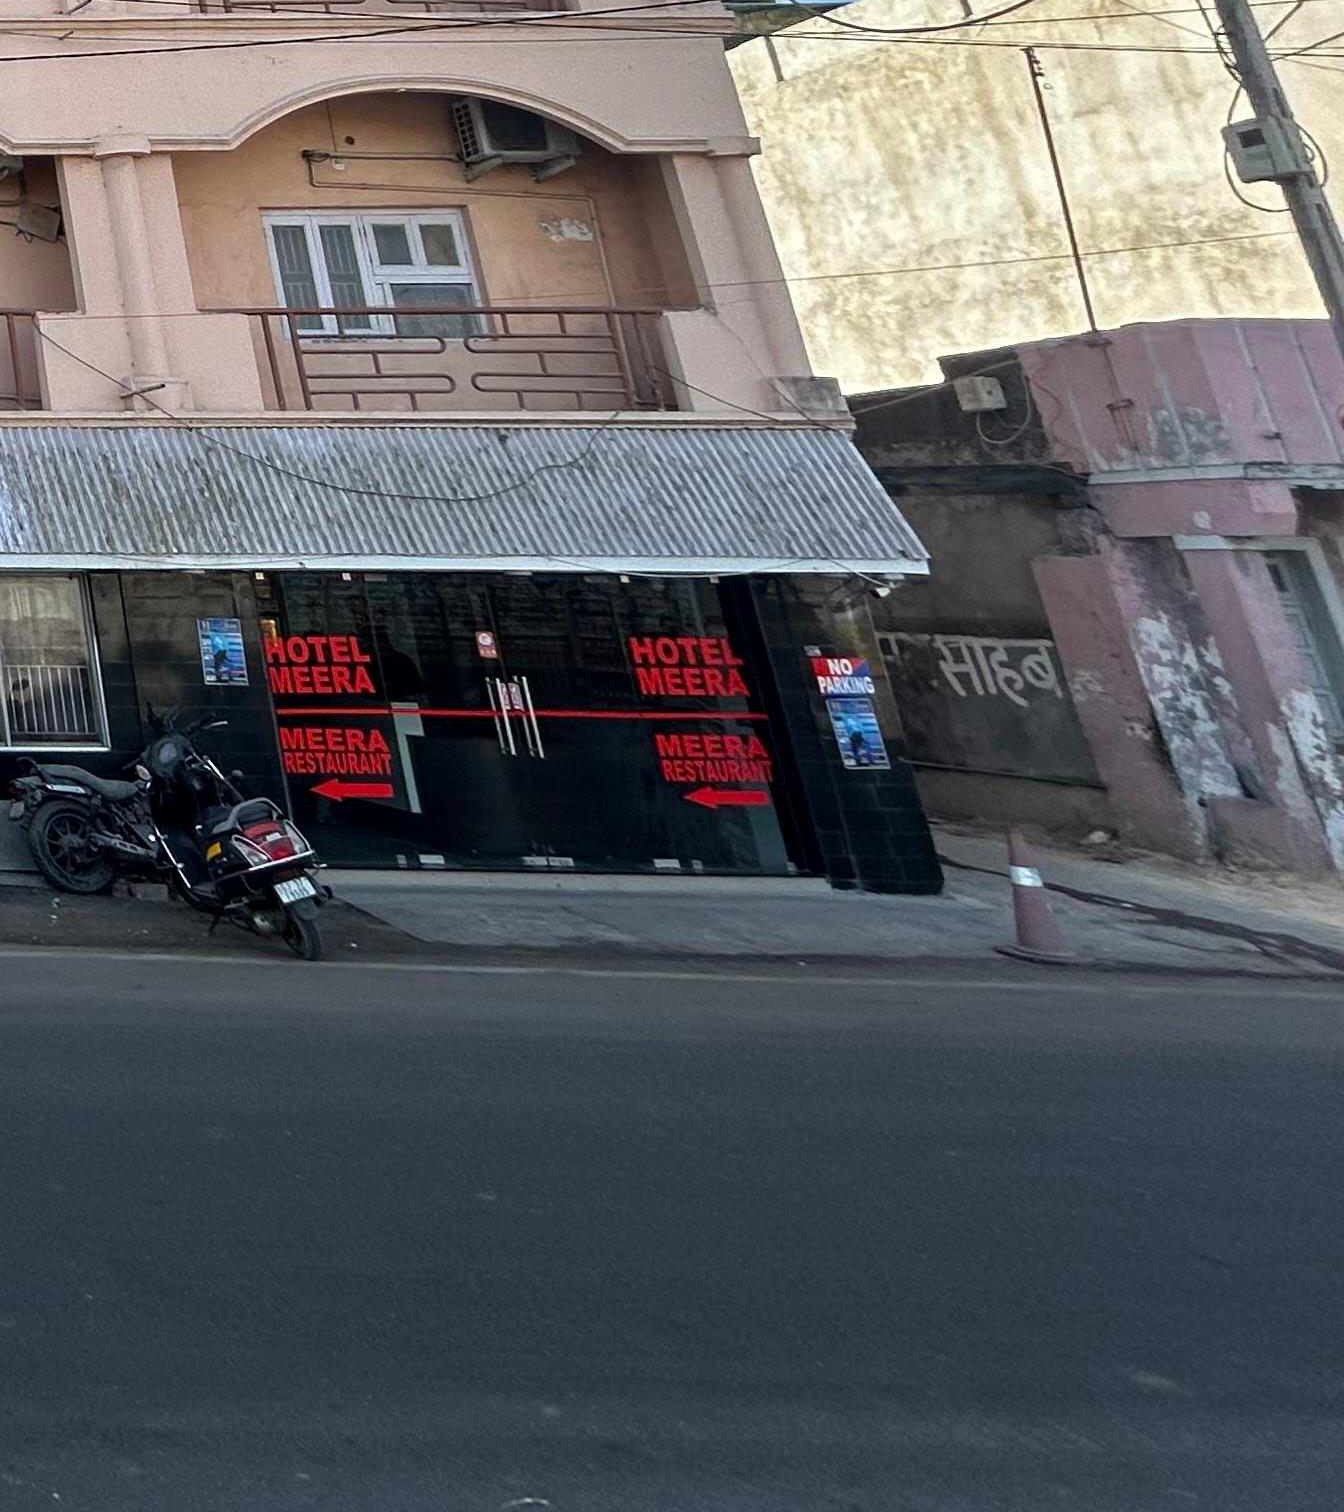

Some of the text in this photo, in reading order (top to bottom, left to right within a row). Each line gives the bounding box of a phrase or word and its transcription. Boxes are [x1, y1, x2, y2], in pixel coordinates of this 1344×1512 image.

[263, 636, 371, 663] HOTEL
[628, 637, 743, 665] HOTEL
[826, 658, 853, 675] NO
[268, 666, 376, 694] MEERA
[635, 667, 750, 696] MEERA
[817, 676, 875, 695] PARKING
[279, 727, 391, 752] MEERA
[655, 734, 769, 758] MEERA
[283, 752, 392, 776] RESTAURANT
[662, 759, 773, 782] RESTAURANT
